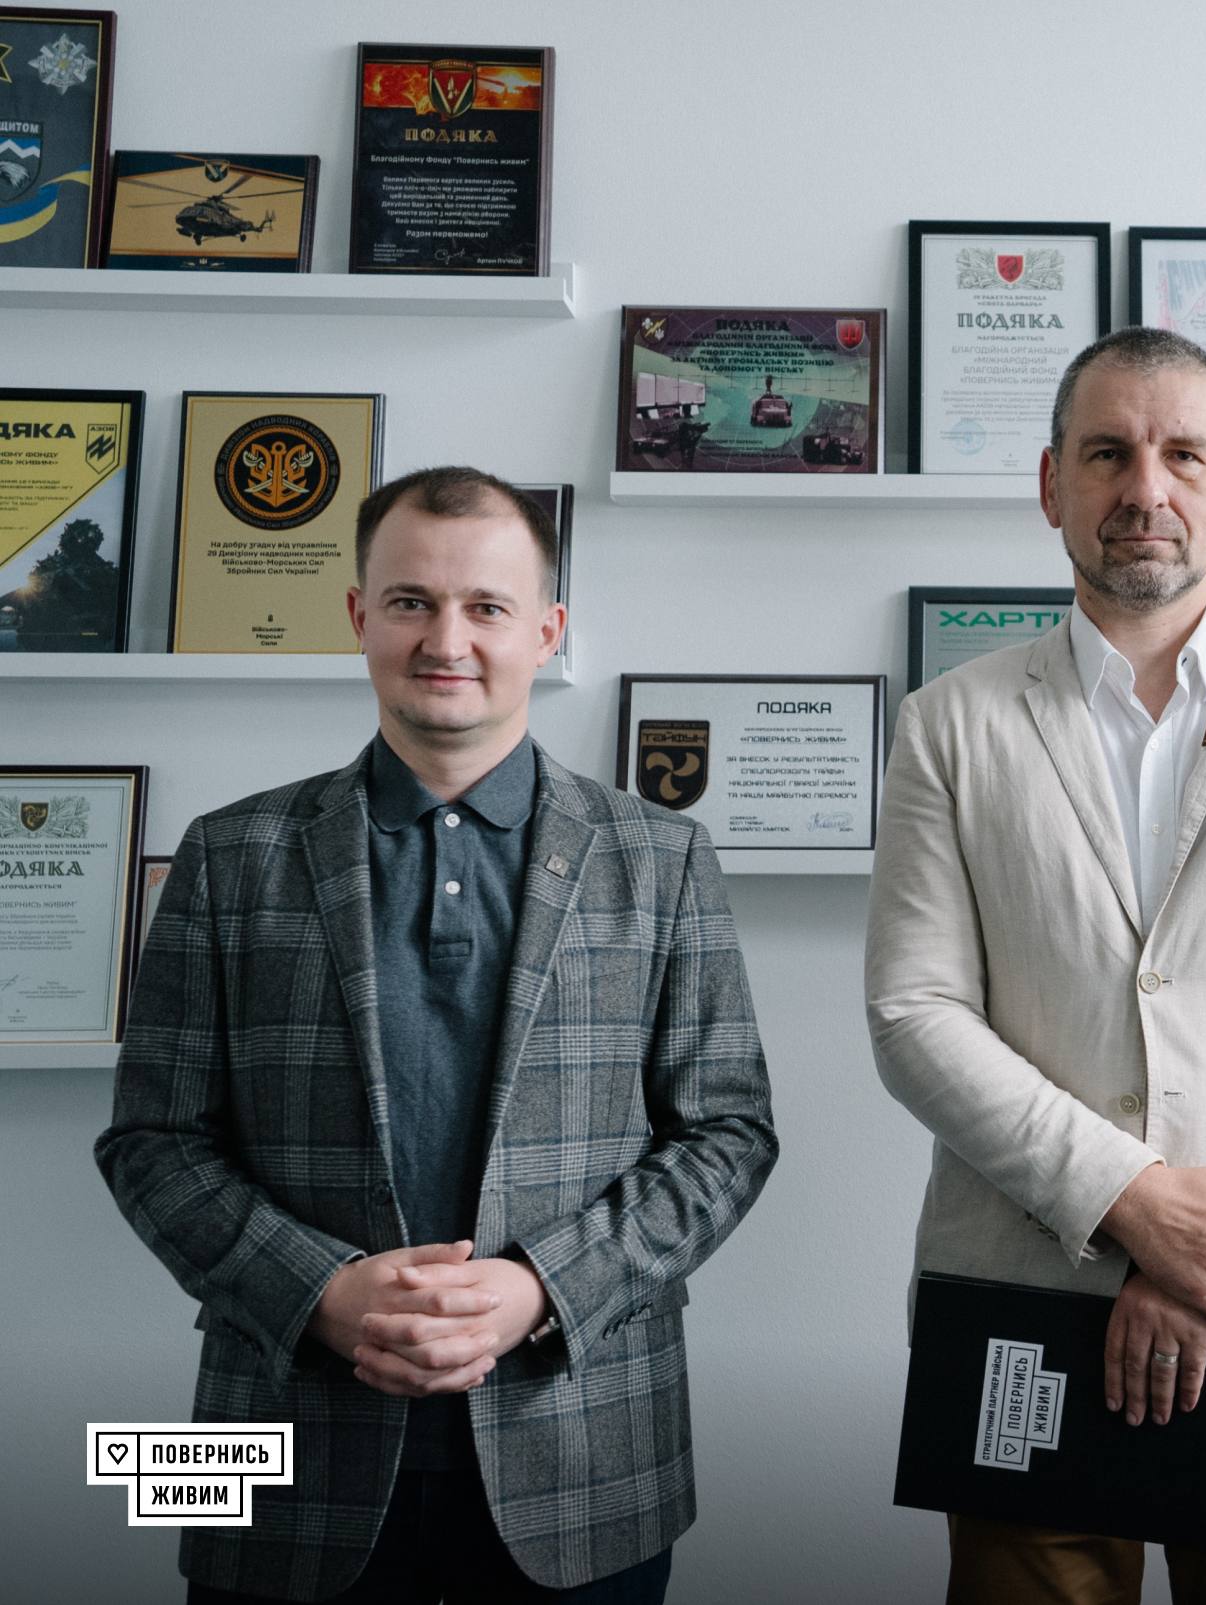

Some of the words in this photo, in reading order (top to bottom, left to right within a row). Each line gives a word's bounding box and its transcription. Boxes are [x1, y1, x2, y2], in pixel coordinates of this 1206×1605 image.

[405, 128, 498, 144] ПОДЯКА
[370, 154, 424, 165] Благодійному
[426, 156, 452, 165] Фонду
[406, 230, 431, 238] Разом
[432, 231, 488, 239] переможемо!
[715, 319, 790, 332] ПОДЯКА
[957, 312, 1065, 331] ПОДЯКА
[1030, 367, 1058, 375] ФОНД
[222, 541, 247, 549] добру
[291, 542, 337, 550] управління
[309, 559, 325, 567] Сил
[226, 567, 267, 576] Збройних
[267, 567, 283, 575] Сил
[939, 610, 1066, 628] ХАРТІ
[756, 701, 832, 714] ПОДЯКА
[740, 735, 801, 743] «ПОВЕРНИСЬ
[804, 735, 847, 743] ЖИВИМ»
[992, 1345, 1004, 1376] ВІЙСЬКА
[989, 1377, 1000, 1409] ПАРТНЕР
[1007, 1357, 1028, 1430] ПОВЕРНИСЬ
[1033, 1385, 1052, 1434] ЖИВИМ
[982, 1410, 995, 1461] СТРАТЕГІЧНИЙ
